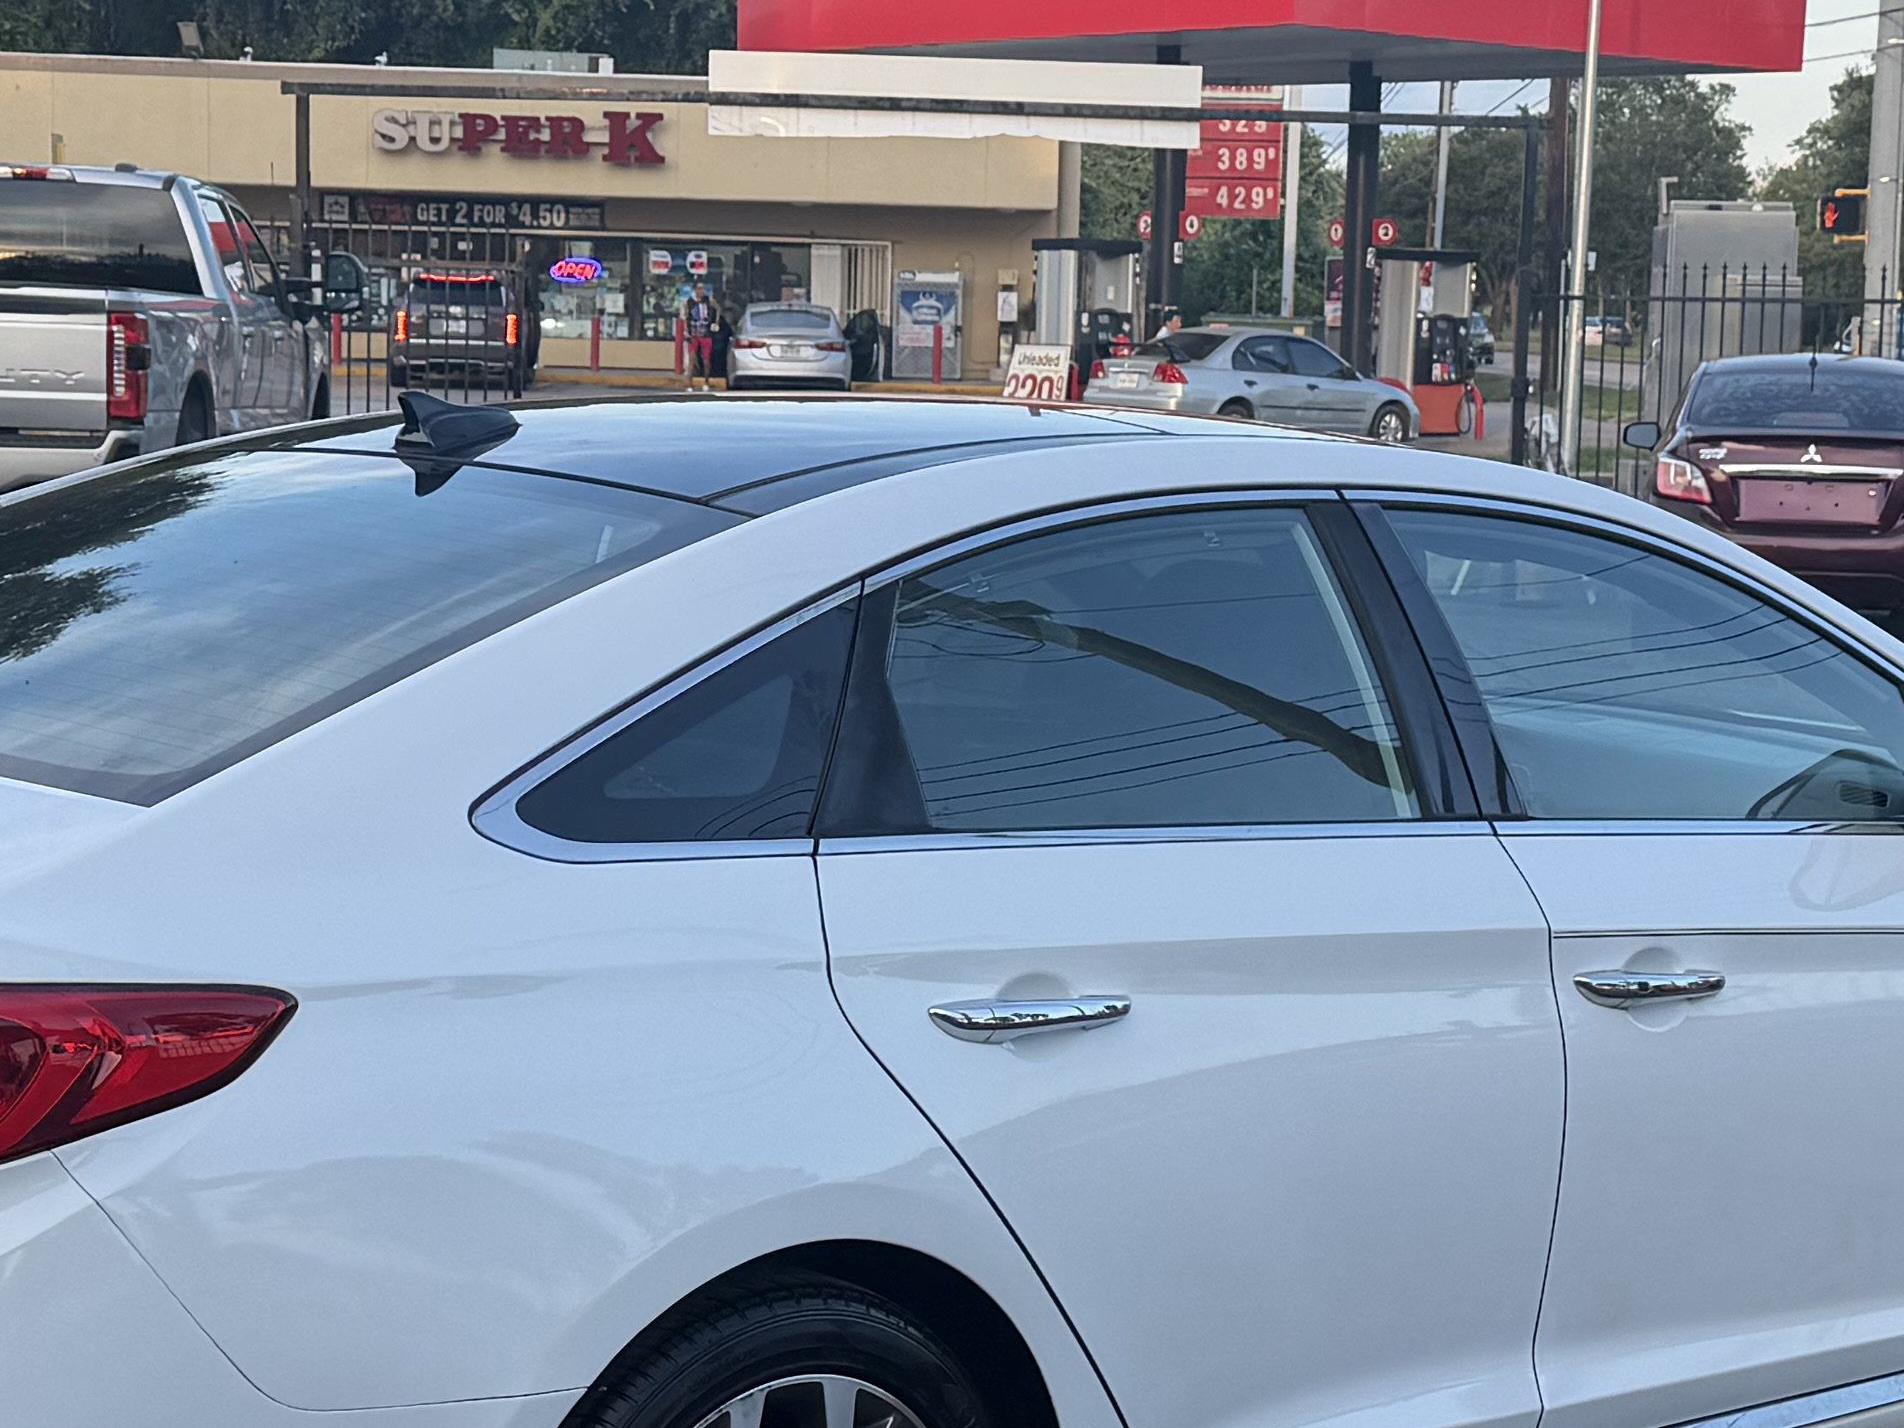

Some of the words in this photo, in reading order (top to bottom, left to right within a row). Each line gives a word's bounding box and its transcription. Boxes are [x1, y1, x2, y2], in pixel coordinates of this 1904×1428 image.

[372, 109, 591, 157] SUPER
[602, 110, 666, 165] K
[416, 204, 449, 223] GET
[454, 204, 468, 224] 2
[473, 205, 506, 224] FOR
[510, 201, 566, 227] $4.50
[554, 260, 596, 280] OPEN
[1018, 351, 1061, 368] Unleaded
